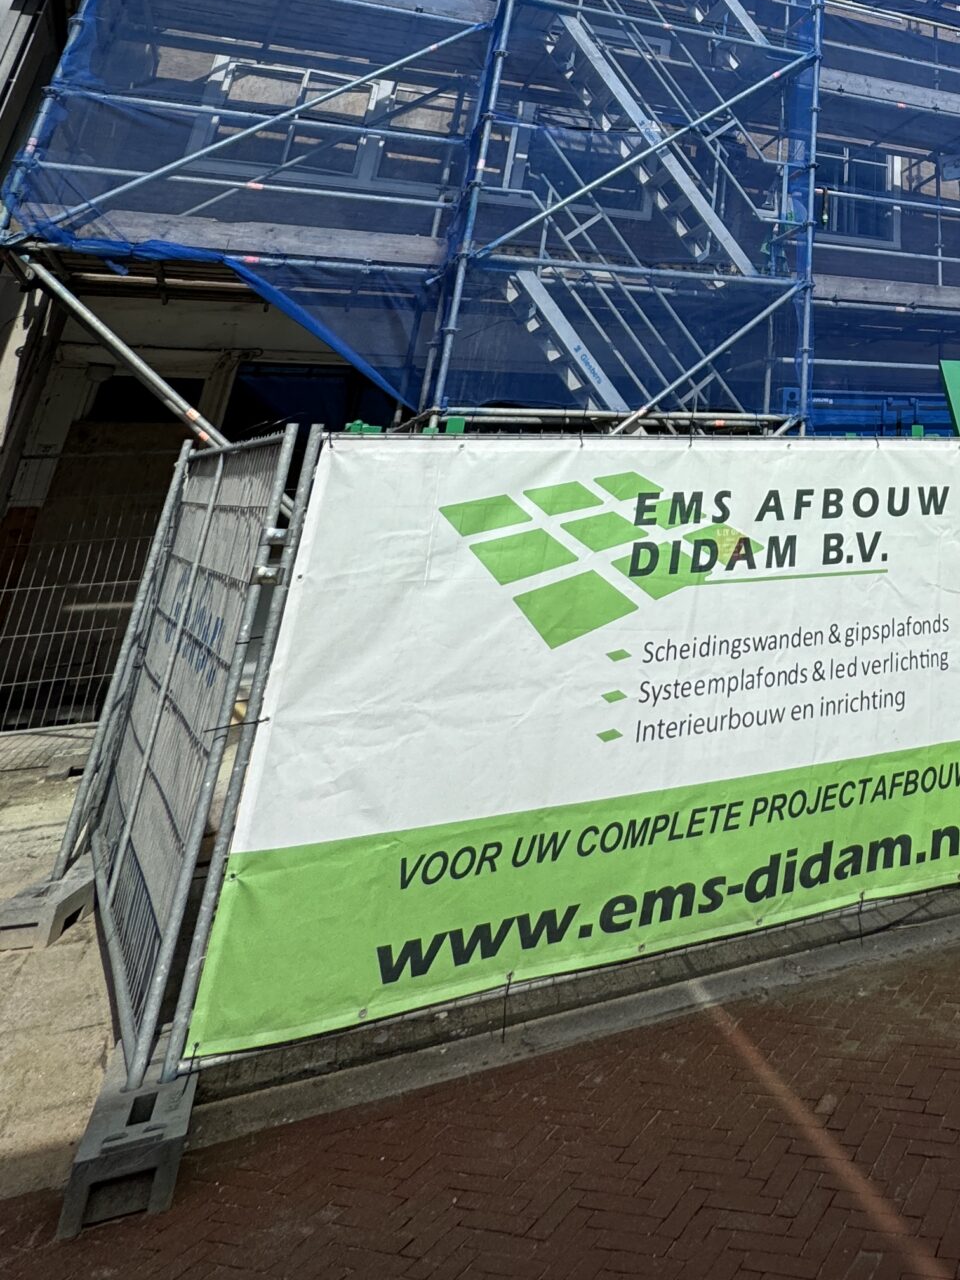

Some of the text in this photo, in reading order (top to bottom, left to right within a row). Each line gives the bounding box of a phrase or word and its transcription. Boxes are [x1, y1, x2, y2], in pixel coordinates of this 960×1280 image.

[633, 486, 950, 526] EMS AFBOUW
[628, 534, 797, 577] DIDAM
[822, 531, 889, 565] B.V.
[642, 613, 950, 663] Scheidingswanden & gipsplafonds
[638, 648, 949, 707] Systeemplafonds & led verlichting
[635, 687, 906, 743] Interieurbouw en inrichting
[400, 841, 502, 890] VOOR
[511, 829, 571, 868] UW
[576, 800, 744, 857] COMPLETE
